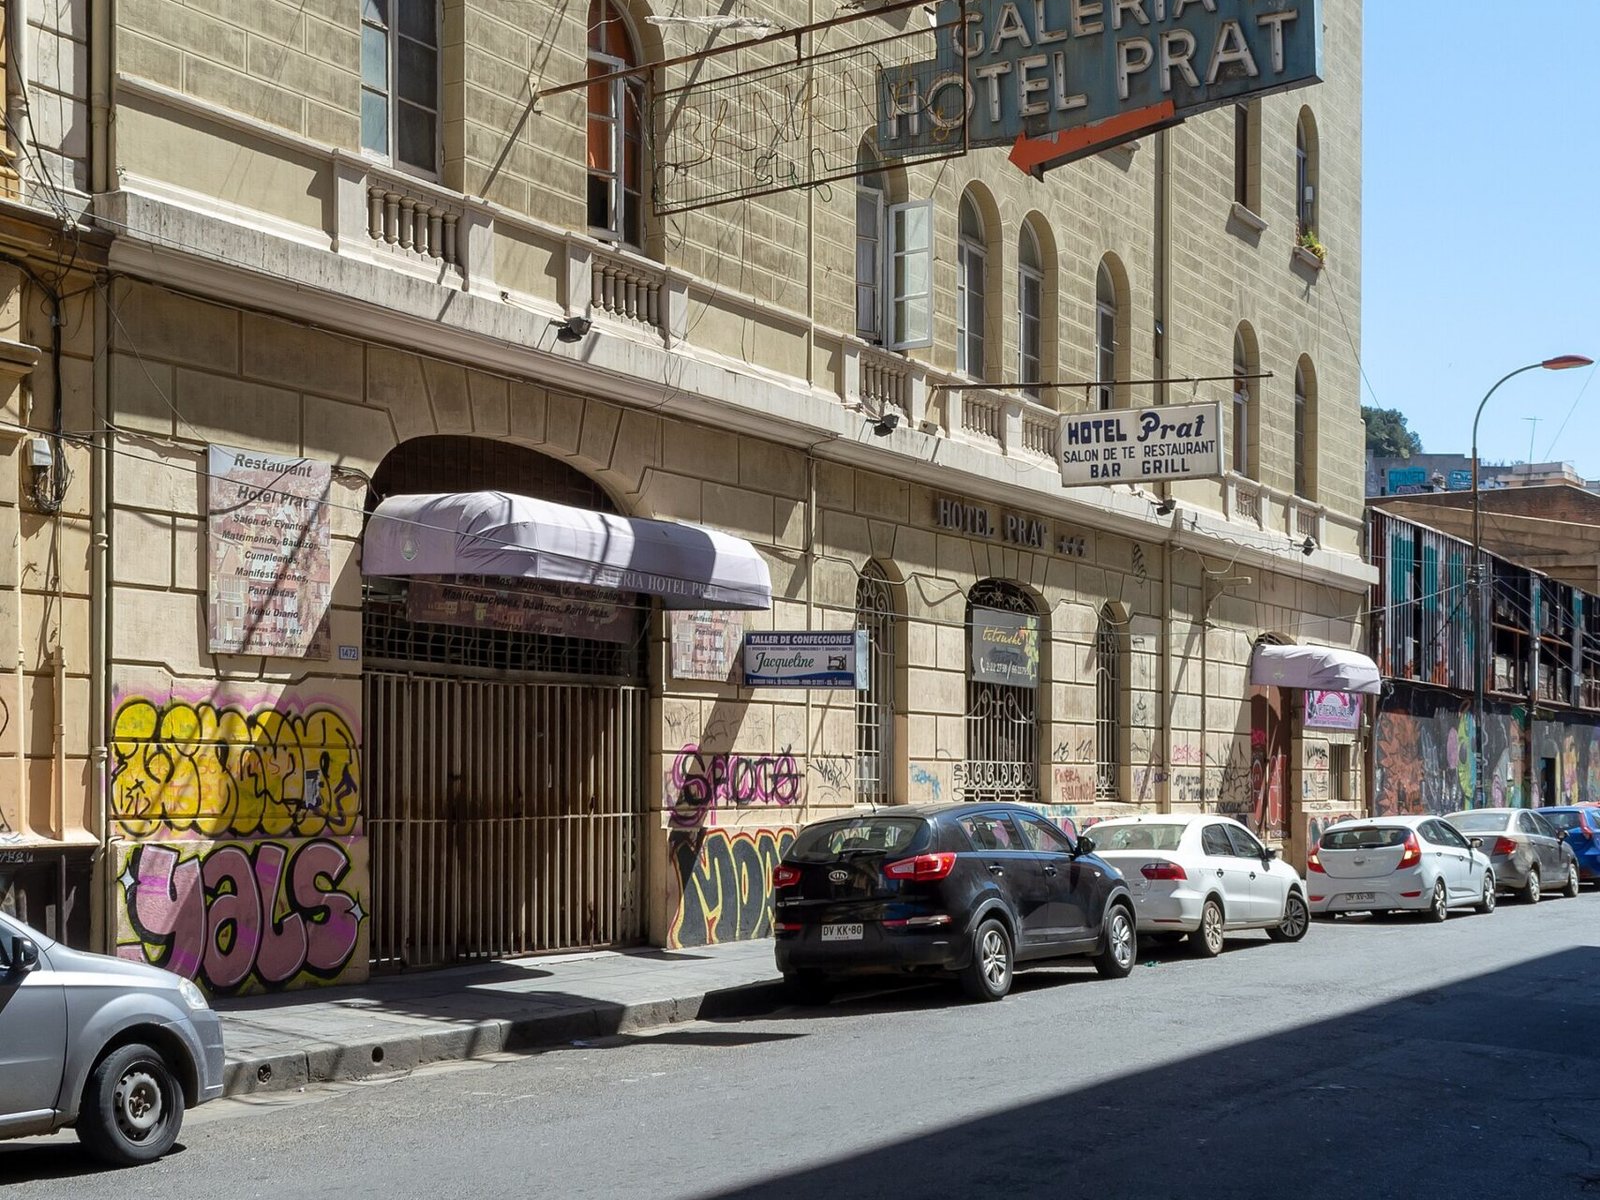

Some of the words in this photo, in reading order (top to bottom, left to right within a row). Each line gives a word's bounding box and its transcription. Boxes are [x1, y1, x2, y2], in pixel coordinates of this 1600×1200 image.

[886, 51, 1088, 140] HOTEL
[1116, 9, 1298, 100] PRAT
[1068, 419, 1127, 445] HOTEL
[1137, 411, 1205, 442] Prat
[1063, 449, 1099, 463] SALON
[1103, 448, 1117, 460] DE
[1122, 446, 1135, 459] TE
[1143, 440, 1215, 458] RESTAURANT
[233, 453, 312, 478] Restaurant
[1090, 462, 1121, 478] BAR
[1142, 458, 1190, 475] GRILL
[237, 486, 276, 503] Hotel
[938, 498, 995, 537] HOTEL
[1005, 514, 1048, 548] PRAT
[648, 575, 688, 595] HOTEL
[751, 635, 778, 644] TALLER
[780, 635, 791, 644] DE
[793, 635, 851, 644] CONFECCIONES
[341, 648, 356, 658] 1472
[751, 651, 815, 674] Jacqueline
